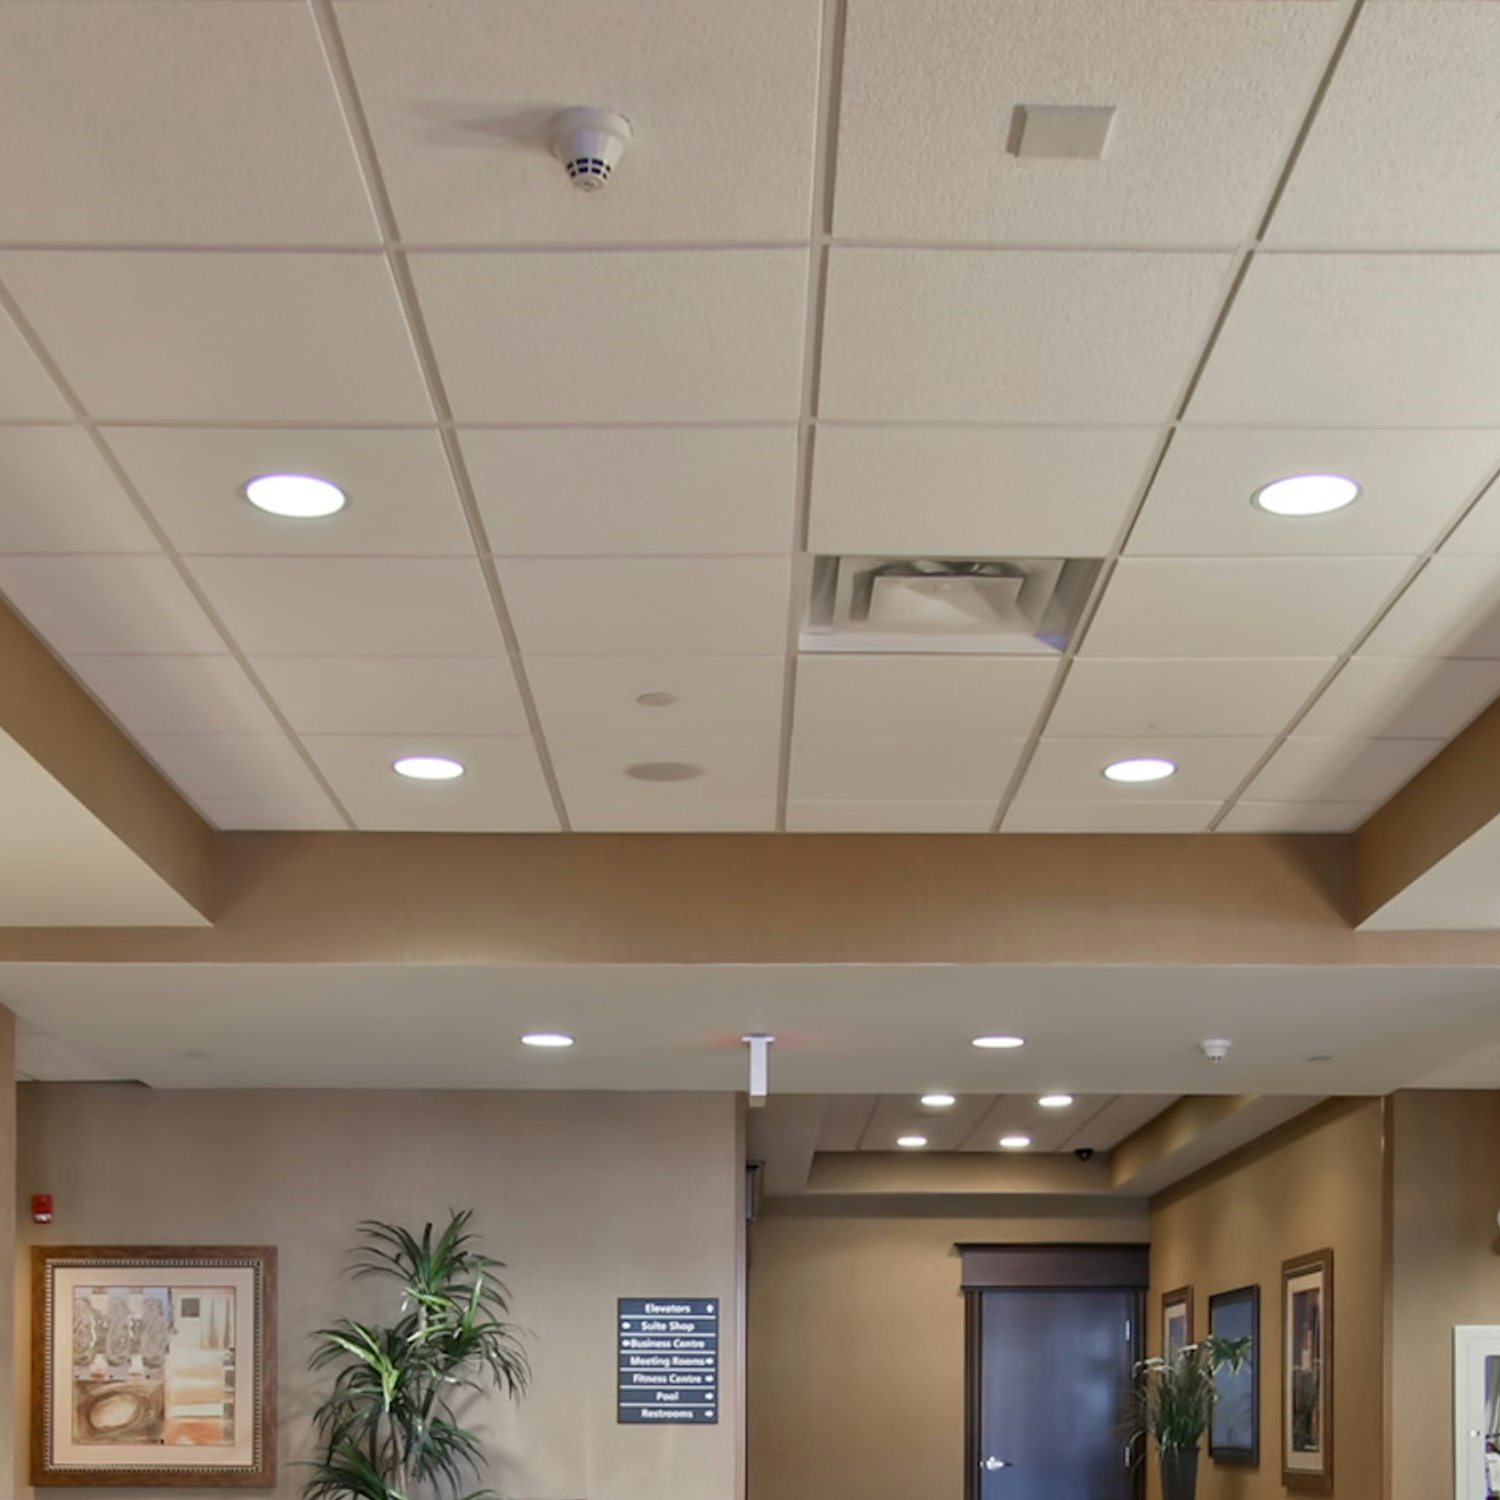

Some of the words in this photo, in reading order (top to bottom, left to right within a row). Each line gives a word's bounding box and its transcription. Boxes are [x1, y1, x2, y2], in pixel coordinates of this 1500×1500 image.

[644, 1303, 691, 1314] Elevators
[641, 1321, 667, 1331] Suite
[669, 1321, 695, 1333] Shop
[630, 1338, 672, 1349] Business
[673, 1339, 705, 1349] Centre
[630, 1355, 670, 1368] Meeting
[672, 1356, 705, 1366] Rooms
[633, 1373, 667, 1383] Fitness
[668, 1373, 702, 1384] Centre
[656, 1391, 679, 1401] Pool
[641, 1408, 694, 1419] Restrooms
